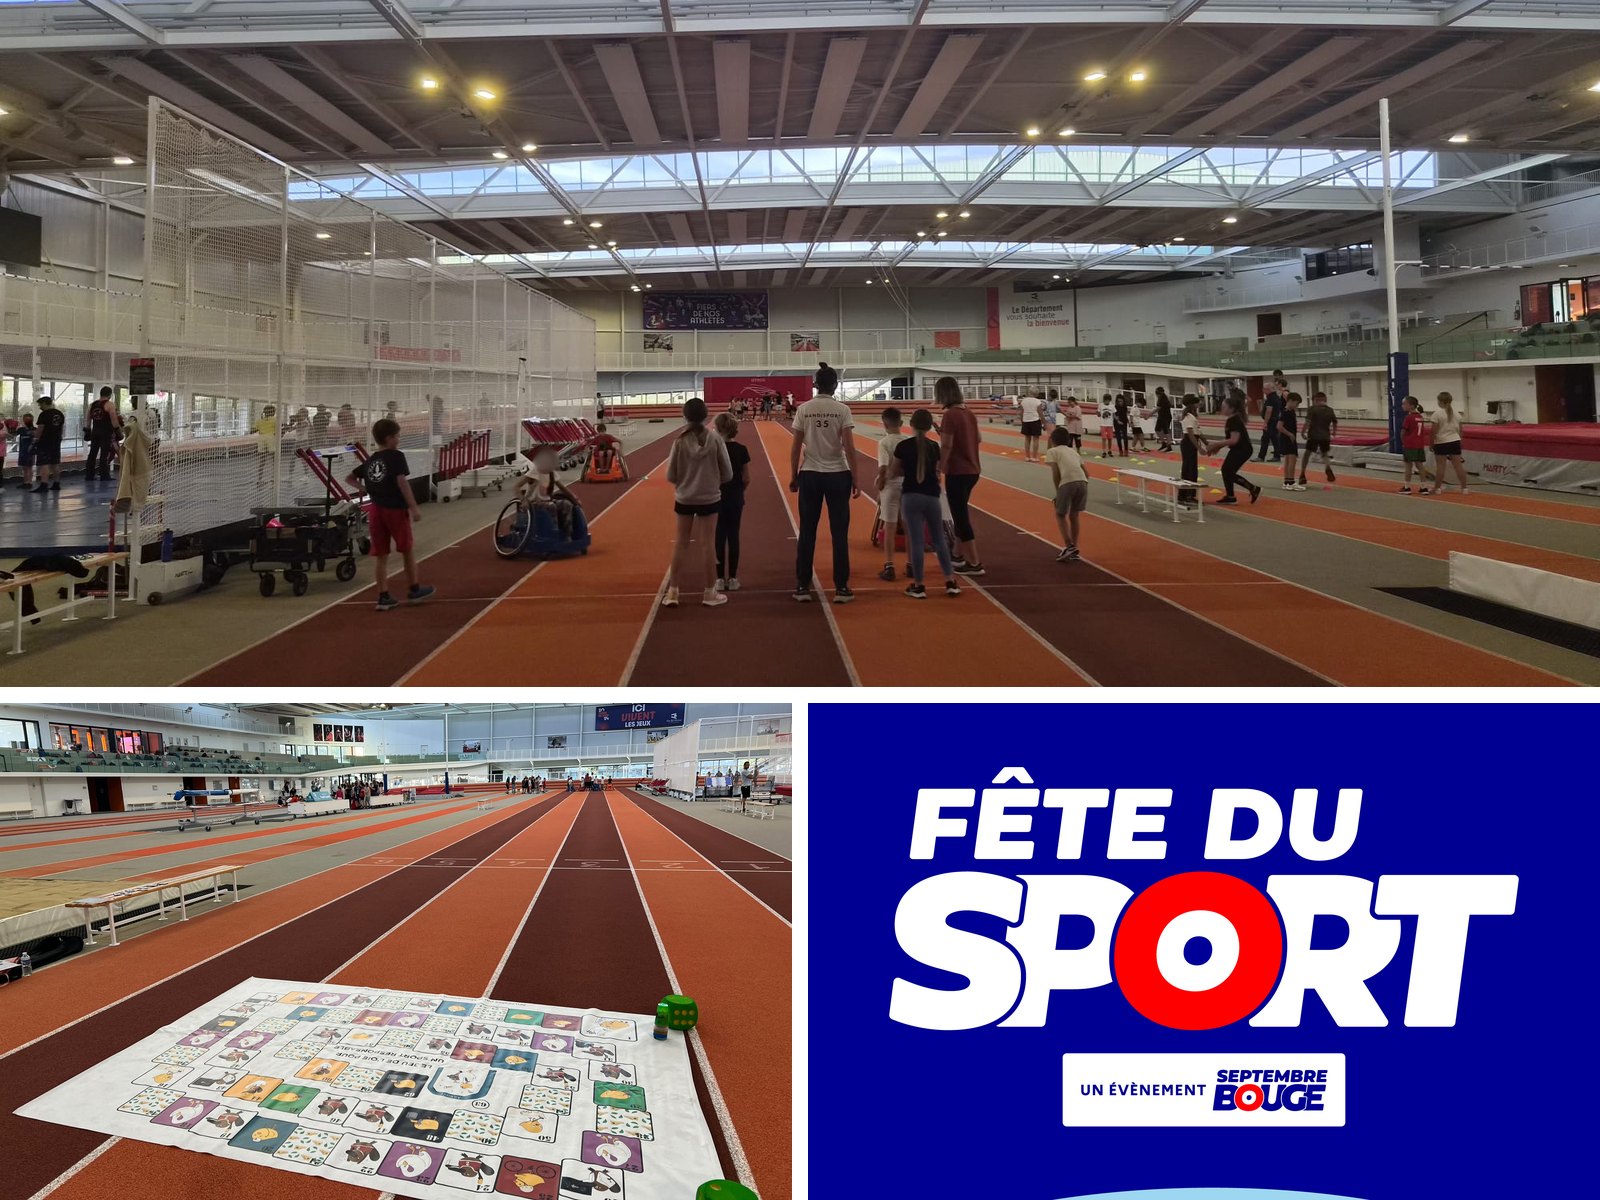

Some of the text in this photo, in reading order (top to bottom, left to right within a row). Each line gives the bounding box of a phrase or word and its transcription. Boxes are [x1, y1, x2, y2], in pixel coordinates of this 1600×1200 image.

[696, 303, 717, 311] FIERS
[1012, 304, 1063, 314] Le Département
[1025, 312, 1056, 320] souhaite
[1035, 319, 1069, 327] bienvenue
[816, 420, 829, 428] 35
[1417, 422, 1423, 436] 7
[1483, 464, 1507, 473] MARTY
[632, 703, 645, 713] ICI
[621, 711, 656, 721] VIVENT
[909, 767, 1363, 861] FÊTE DU
[889, 870, 1520, 1031] SPORT
[334, 1045, 397, 1057] RESPONSABLE
[335, 1052, 361, 1060] POUR
[399, 1052, 428, 1061] SPORT
[386, 1058, 400, 1066] DE
[401, 1060, 419, 1068] JEU
[1216, 1069, 1328, 1083] SEPTEMBRE
[1080, 1081, 1207, 1096] UN ÉVÈNEMENT
[1212, 1083, 1327, 1112] BOUGE
[426, 1134, 440, 1142] 48
[360, 1166, 374, 1174] 22
